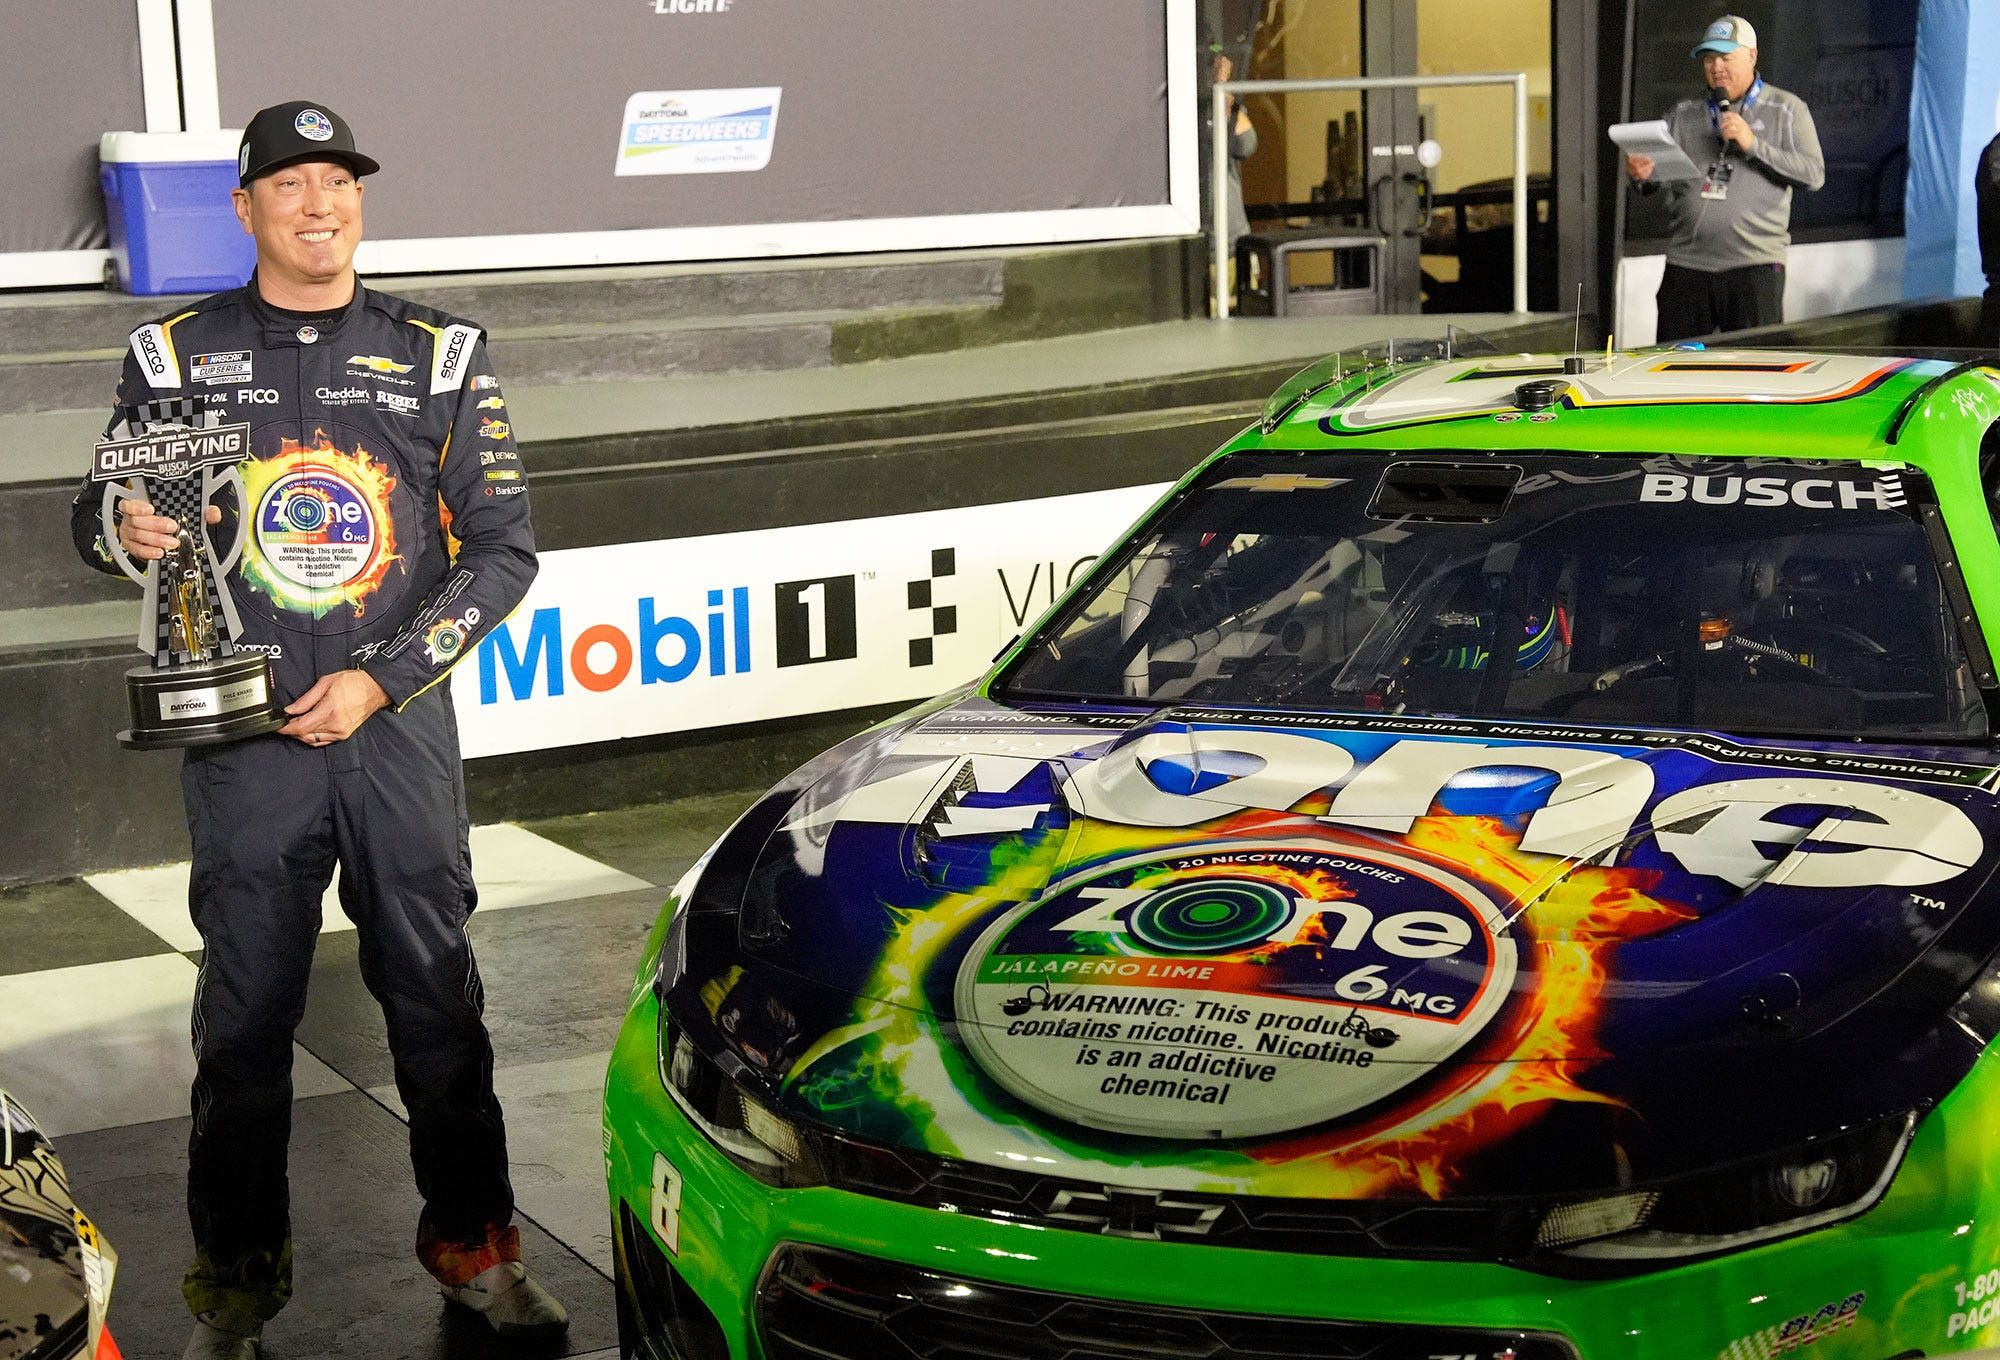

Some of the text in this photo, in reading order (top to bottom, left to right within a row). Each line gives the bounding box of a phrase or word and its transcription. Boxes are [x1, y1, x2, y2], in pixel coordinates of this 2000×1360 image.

[639, 110, 687, 119] DAYTONA
[634, 120, 762, 143] SPEEDWEEKS
[138, 329, 165, 376] sparco
[209, 353, 243, 363] NASCAR
[440, 330, 467, 380] sparco
[199, 364, 244, 376] CUP SERIES
[346, 369, 416, 386] CHEVROLET
[211, 393, 228, 403] OIL
[237, 389, 279, 404] FICO
[101, 433, 241, 470] QUALIFYING
[149, 434, 177, 444] DAYTONA
[158, 461, 189, 474] BUSCH
[1640, 473, 1907, 510] BUSCH
[342, 527, 366, 542] 6 MG
[283, 546, 317, 554] WARNING:
[332, 547, 353, 555] product
[477, 586, 751, 705] Mobil
[797, 583, 827, 659] 1
[170, 701, 207, 711] DAYTONA
[950, 711, 1968, 778] WARNING: This oduct contains nicotine. Nicotine is an Addictive chemical.
[1178, 853, 1406, 884] 20 NICOTINE POUCHES
[1049, 879, 1472, 959] zone
[992, 959, 1215, 980] JALAPEÑO LIME
[1335, 964, 1456, 1013] 6 MG
[1043, 993, 1367, 1040] WARNING: This product
[1007, 1018, 1374, 1068] contains nicotine. Nicotine
[1075, 1045, 1277, 1083] is an addictive
[1100, 1073, 1230, 1105] chemical
[650, 1151, 684, 1258] 8
[1954, 1269, 2000, 1307] 1-80
